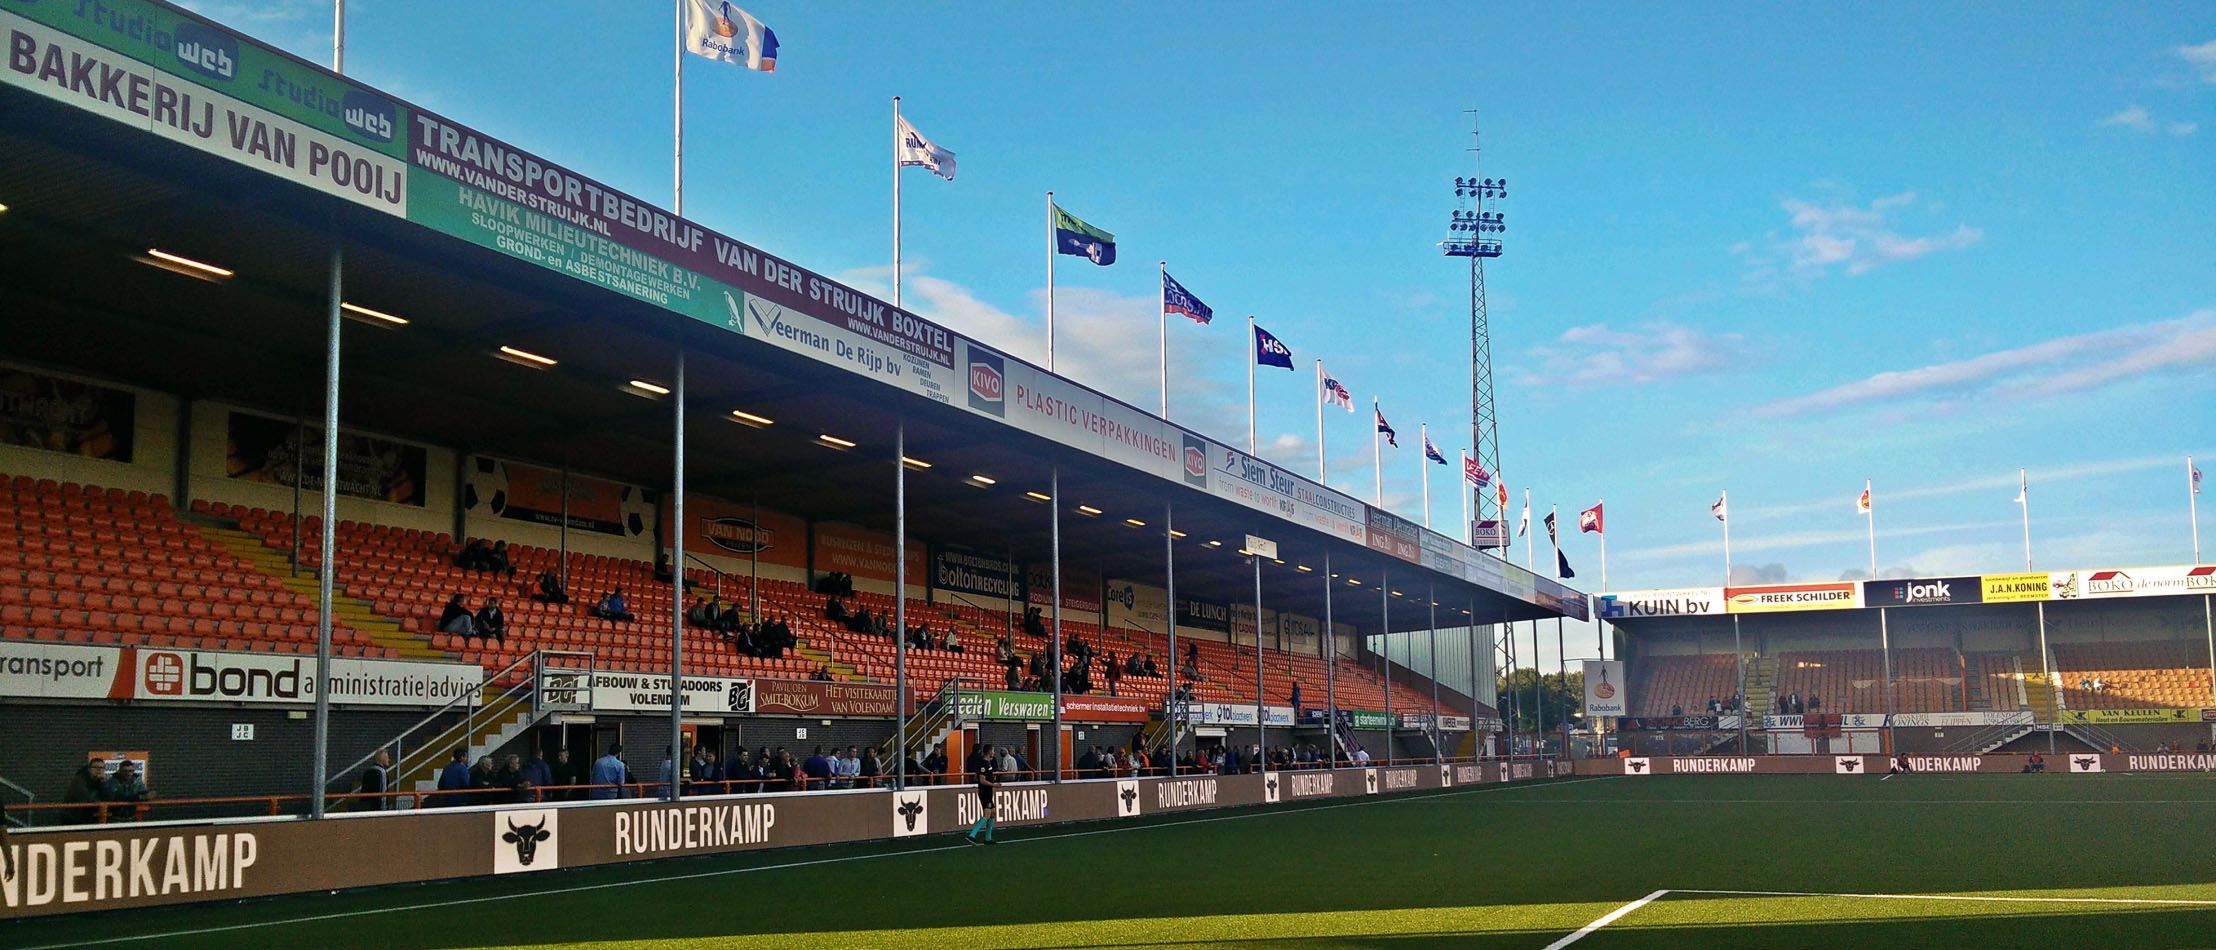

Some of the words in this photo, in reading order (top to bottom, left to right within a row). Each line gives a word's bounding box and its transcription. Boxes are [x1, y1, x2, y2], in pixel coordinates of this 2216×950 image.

[702, 37, 745, 57] Rabobank
[9, 29, 215, 139] BAKKERIJ
[227, 108, 296, 169] VAN
[309, 139, 402, 205] POOIJ
[416, 148, 612, 238] WWW.VANDERSTRUIJK.NL
[416, 113, 704, 253] TRANSPORTBEDRIJF
[714, 237, 757, 277] VAN
[764, 256, 804, 295] DER
[809, 277, 885, 327] STRUIJK
[892, 311, 952, 353] BOXTEL
[459, 186, 521, 225] HAVIK
[526, 211, 669, 277] MILIEUTECHNIEK
[674, 264, 701, 292] B.V.
[471, 212, 565, 256] SLOOPWERKEN
[580, 251, 691, 301] DEMONTAGEWERKEN
[496, 236, 546, 262] GROND-
[547, 254, 562, 268] en
[565, 258, 669, 305] ASBESTSANERING
[847, 316, 951, 366] WWW.VANDERSTRUIJK.NL
[836, 339, 854, 360] De
[857, 346, 883, 374] Rijp
[886, 356, 901, 377] bv
[972, 369, 1000, 395] KIVO
[1017, 384, 1078, 425] PLASTIC
[1082, 409, 1177, 463] VERPAKKINGEN
[1186, 452, 1204, 470] KIVO
[1241, 455, 1266, 486] Siem
[1270, 467, 1295, 497] Steur
[1297, 486, 1356, 520] STAALCONSTRUCTIES
[706, 522, 733, 539] VAN
[1475, 528, 1496, 536] BOKO
[1372, 533, 1384, 548] ING
[1397, 542, 1409, 557] ING
[1906, 580, 1951, 603] jonk
[1990, 582, 2048, 594] J.A.N.KONING
[2088, 579, 2134, 592] BOKO
[1630, 599, 1680, 616] KUIN
[1686, 598, 1710, 614] bv
[1761, 593, 1794, 603] FREEK
[1796, 591, 1851, 602] SCHILDER
[1912, 595, 1951, 603] investments
[1190, 600, 1200, 617] DE
[1202, 602, 1227, 622] LUNCH
[189, 652, 300, 699] bond
[640, 677, 650, 690] &
[653, 678, 723, 692] STUADOORS
[629, 692, 690, 706] VOLENDM
[831, 701, 848, 713] VAN
[998, 697, 1049, 717] Verswaren
[1589, 703, 1622, 712] Rabobank
[2102, 709, 2119, 717] VAN
[2124, 709, 2160, 717] KEULEN
[1673, 758, 1755, 773] RUNDERKAMP
[1890, 758, 1981, 774] RNDERKAMP
[1291, 773, 1333, 797] RUNDERKAMP
[1385, 769, 1417, 789] RUNDERKAMP
[1158, 779, 1217, 809] RUNDERKAMP
[957, 788, 1049, 826] RUNERKAMP
[615, 803, 776, 856] RUNDERKAMP
